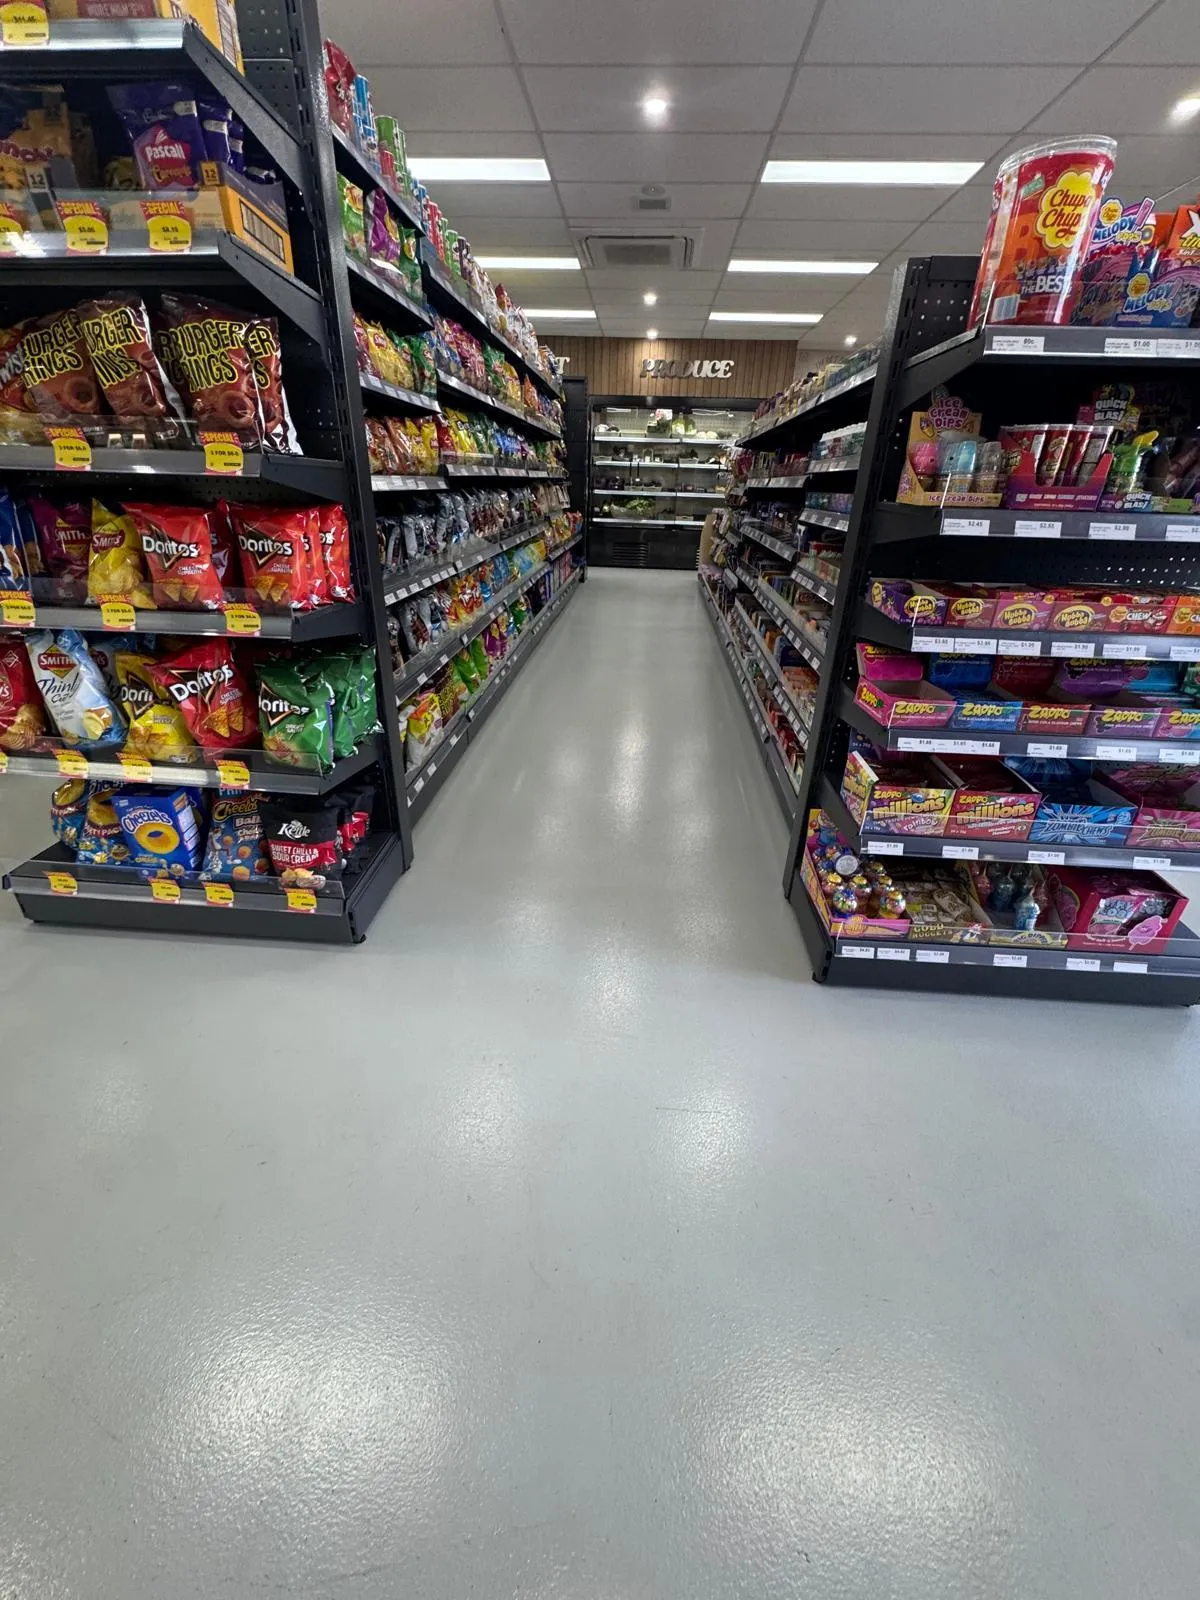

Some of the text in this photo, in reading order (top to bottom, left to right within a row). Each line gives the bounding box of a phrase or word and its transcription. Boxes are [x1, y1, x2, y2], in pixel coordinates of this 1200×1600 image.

[144, 143, 186, 163] Pascall
[29, 173, 45, 186] 12
[204, 168, 217, 179] 12
[147, 202, 181, 214] SPECIAL
[1042, 208, 1084, 230] Chup
[1092, 215, 1137, 242] MELODY
[1020, 274, 1070, 295] THE BES
[1124, 282, 1174, 311] MELODY
[22, 309, 83, 358] URGER
[83, 308, 145, 354] URGER
[170, 319, 250, 361] BURGER
[90, 344, 143, 390] INGS
[183, 351, 240, 393] RINGS
[640, 359, 735, 379] PRODUCE
[1095, 397, 1127, 410] QUICK
[1094, 410, 1124, 422] BLAST
[1123, 500, 1148, 510] BLAST
[1125, 492, 1152, 501] QUICK
[142, 534, 200, 558] Doritos
[237, 534, 293, 556] Doritos
[1004, 609, 1027, 620] Hubba
[1061, 611, 1086, 622] Hubba
[1126, 611, 1152, 621] CHEW
[40, 653, 75, 667] SMITH
[169, 664, 234, 702] Doritos
[121, 686, 154, 702] Dori
[873, 790, 902, 800] ZAPPO
[958, 795, 989, 805] ZAPPO
[212, 801, 259, 822] Cheetos
[872, 796, 946, 821] millions
[956, 802, 1035, 826] millions
[120, 808, 174, 835] Cheezels
[277, 821, 311, 840] Kettle
[1042, 820, 1113, 837] ZOMBIE CHEWS
[271, 843, 291, 853] SWEET
[271, 850, 319, 864] SOUR CREAM
